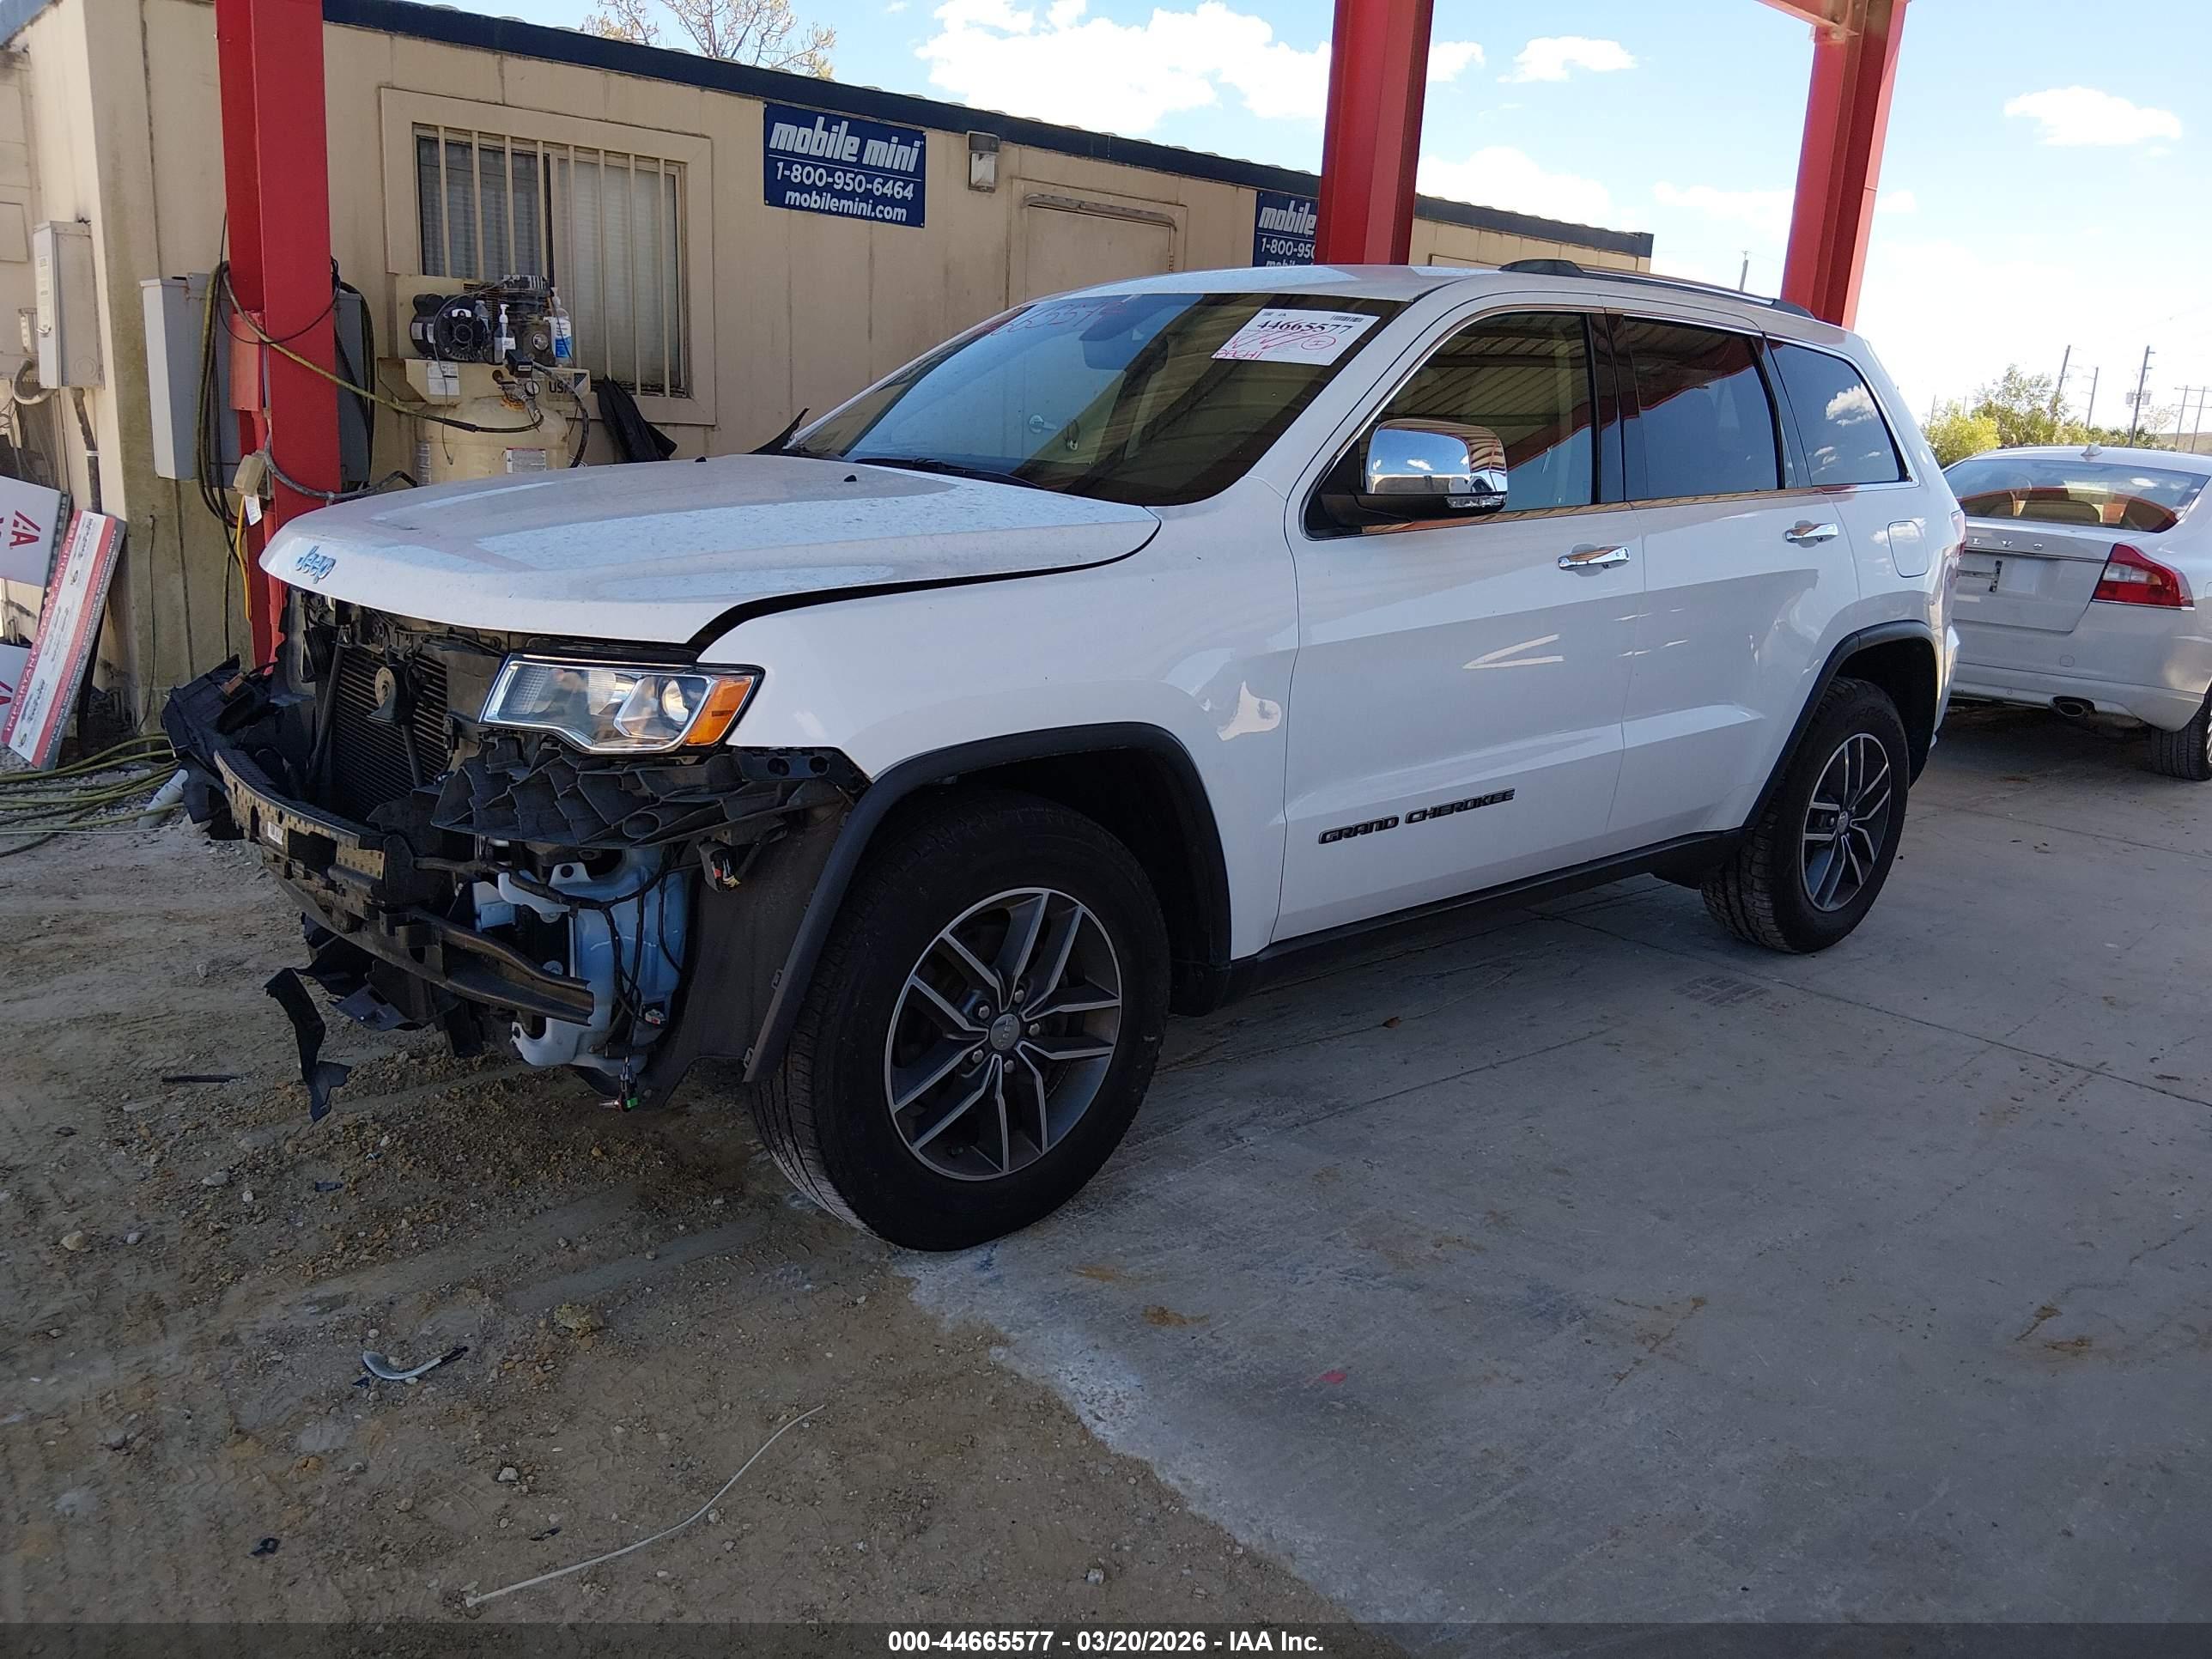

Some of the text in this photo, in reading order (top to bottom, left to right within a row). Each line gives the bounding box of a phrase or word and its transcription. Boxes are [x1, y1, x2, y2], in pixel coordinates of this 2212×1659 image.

[769, 116, 921, 173] mobile mini
[776, 161, 915, 201] 1-800-950-6464
[785, 191, 908, 222] mobilemini.com
[1258, 200, 1317, 235] mobile
[1257, 319, 1354, 335] 44665577
[1971, 537, 2044, 551] LVO
[295, 544, 337, 584] Jeep
[1318, 788, 1516, 845] GRAND CHEROKEE
